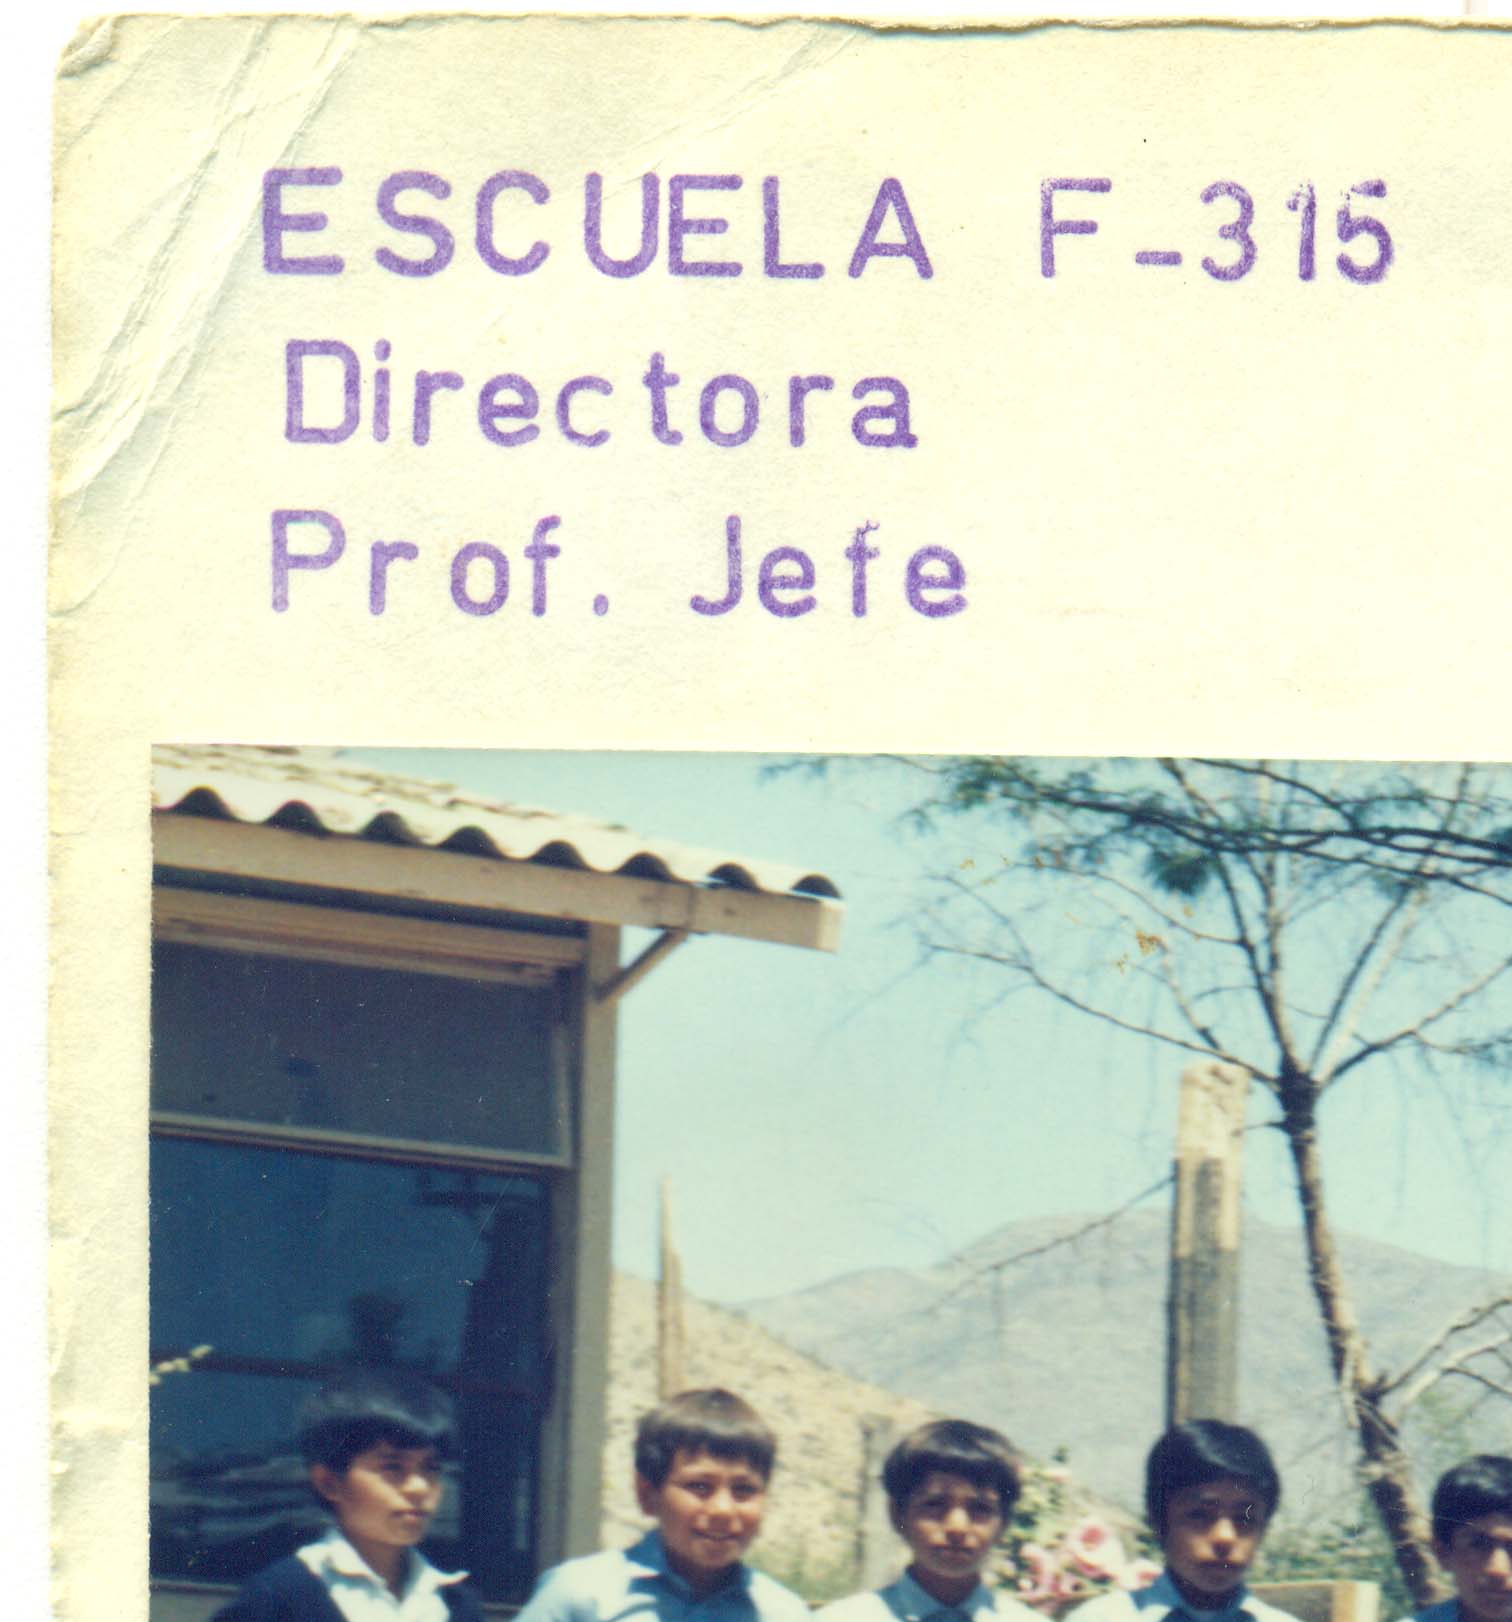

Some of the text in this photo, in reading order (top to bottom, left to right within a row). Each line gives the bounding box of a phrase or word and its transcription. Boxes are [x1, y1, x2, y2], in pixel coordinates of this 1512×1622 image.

[262, 167, 1395, 286] ESCUELA F-315
[284, 339, 919, 450] Directora
[270, 509, 971, 619] Prof. Jefe
